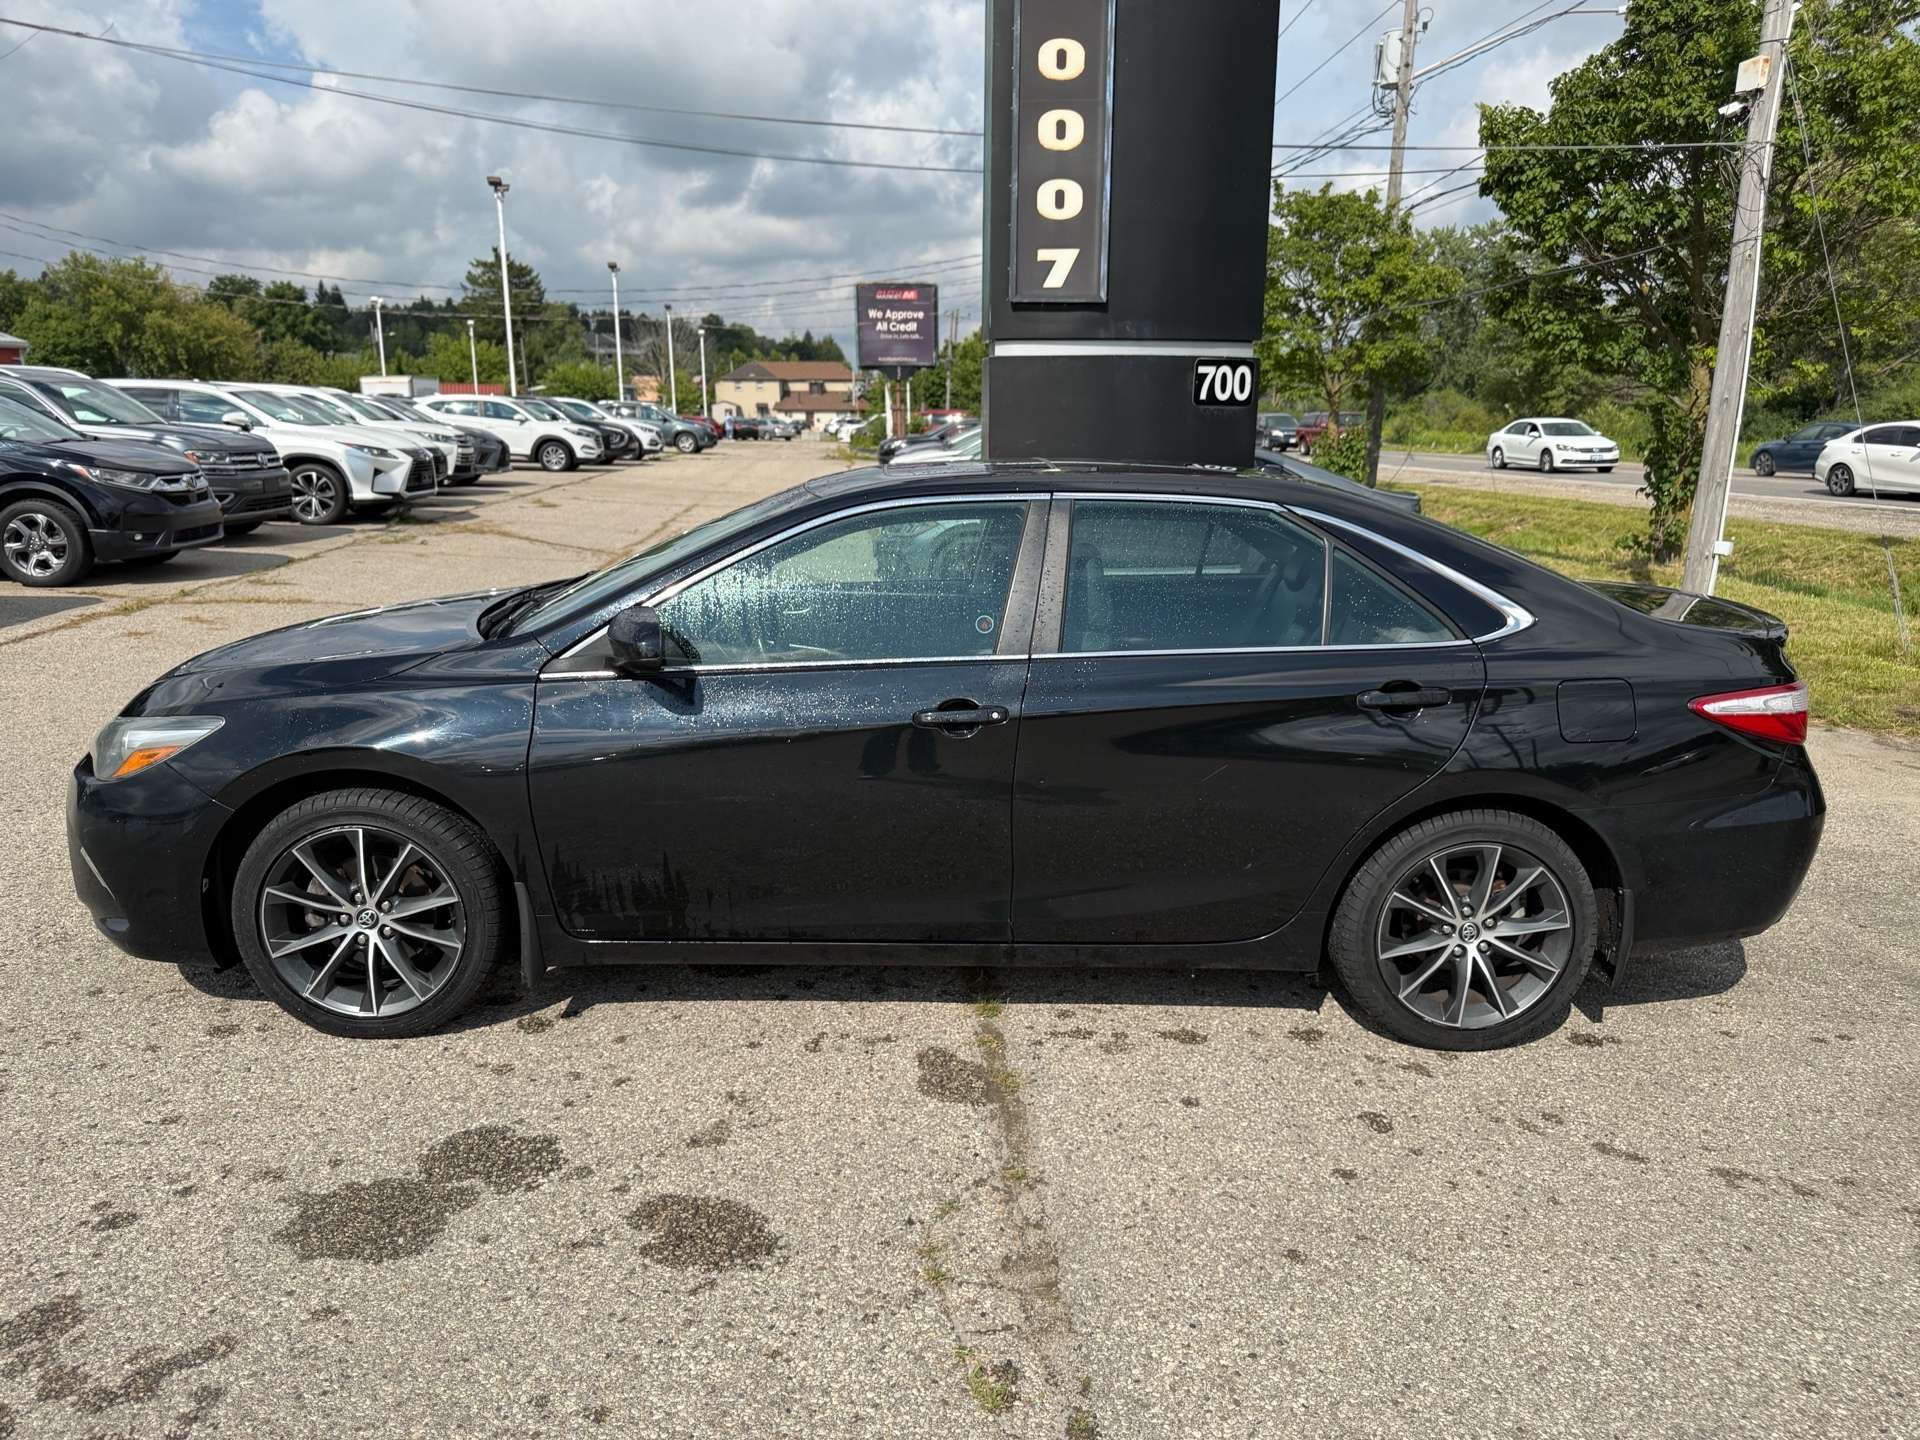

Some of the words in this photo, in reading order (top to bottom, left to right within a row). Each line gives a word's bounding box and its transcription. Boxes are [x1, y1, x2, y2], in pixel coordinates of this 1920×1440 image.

[1037, 38, 1085, 288] 0007
[868, 309, 883, 319] We
[885, 309, 924, 320] Approve
[876, 322, 887, 331] All
[889, 322, 917, 331] Credit
[1198, 365, 1252, 401] 700
